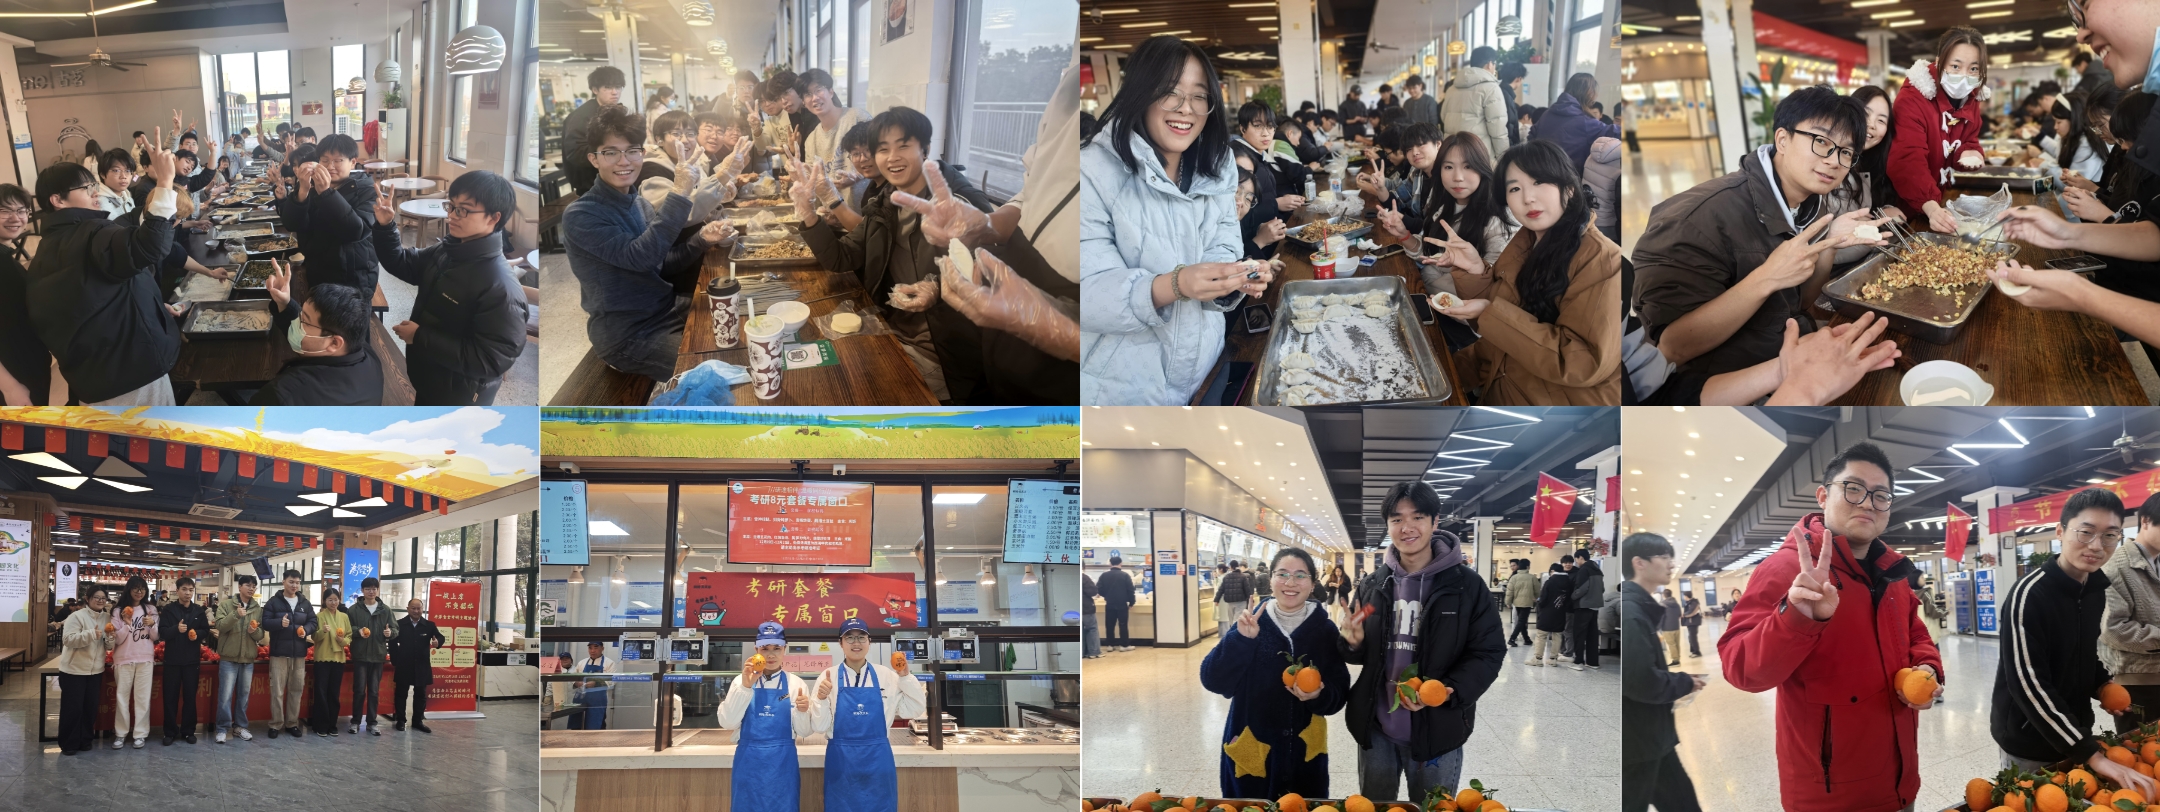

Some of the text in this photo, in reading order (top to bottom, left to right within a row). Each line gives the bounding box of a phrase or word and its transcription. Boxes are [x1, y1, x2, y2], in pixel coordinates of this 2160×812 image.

[749, 494, 848, 507] 考研8元套餐专属窗口
[746, 577, 834, 598] 考研套餐
[771, 603, 859, 624] 专属窗口
